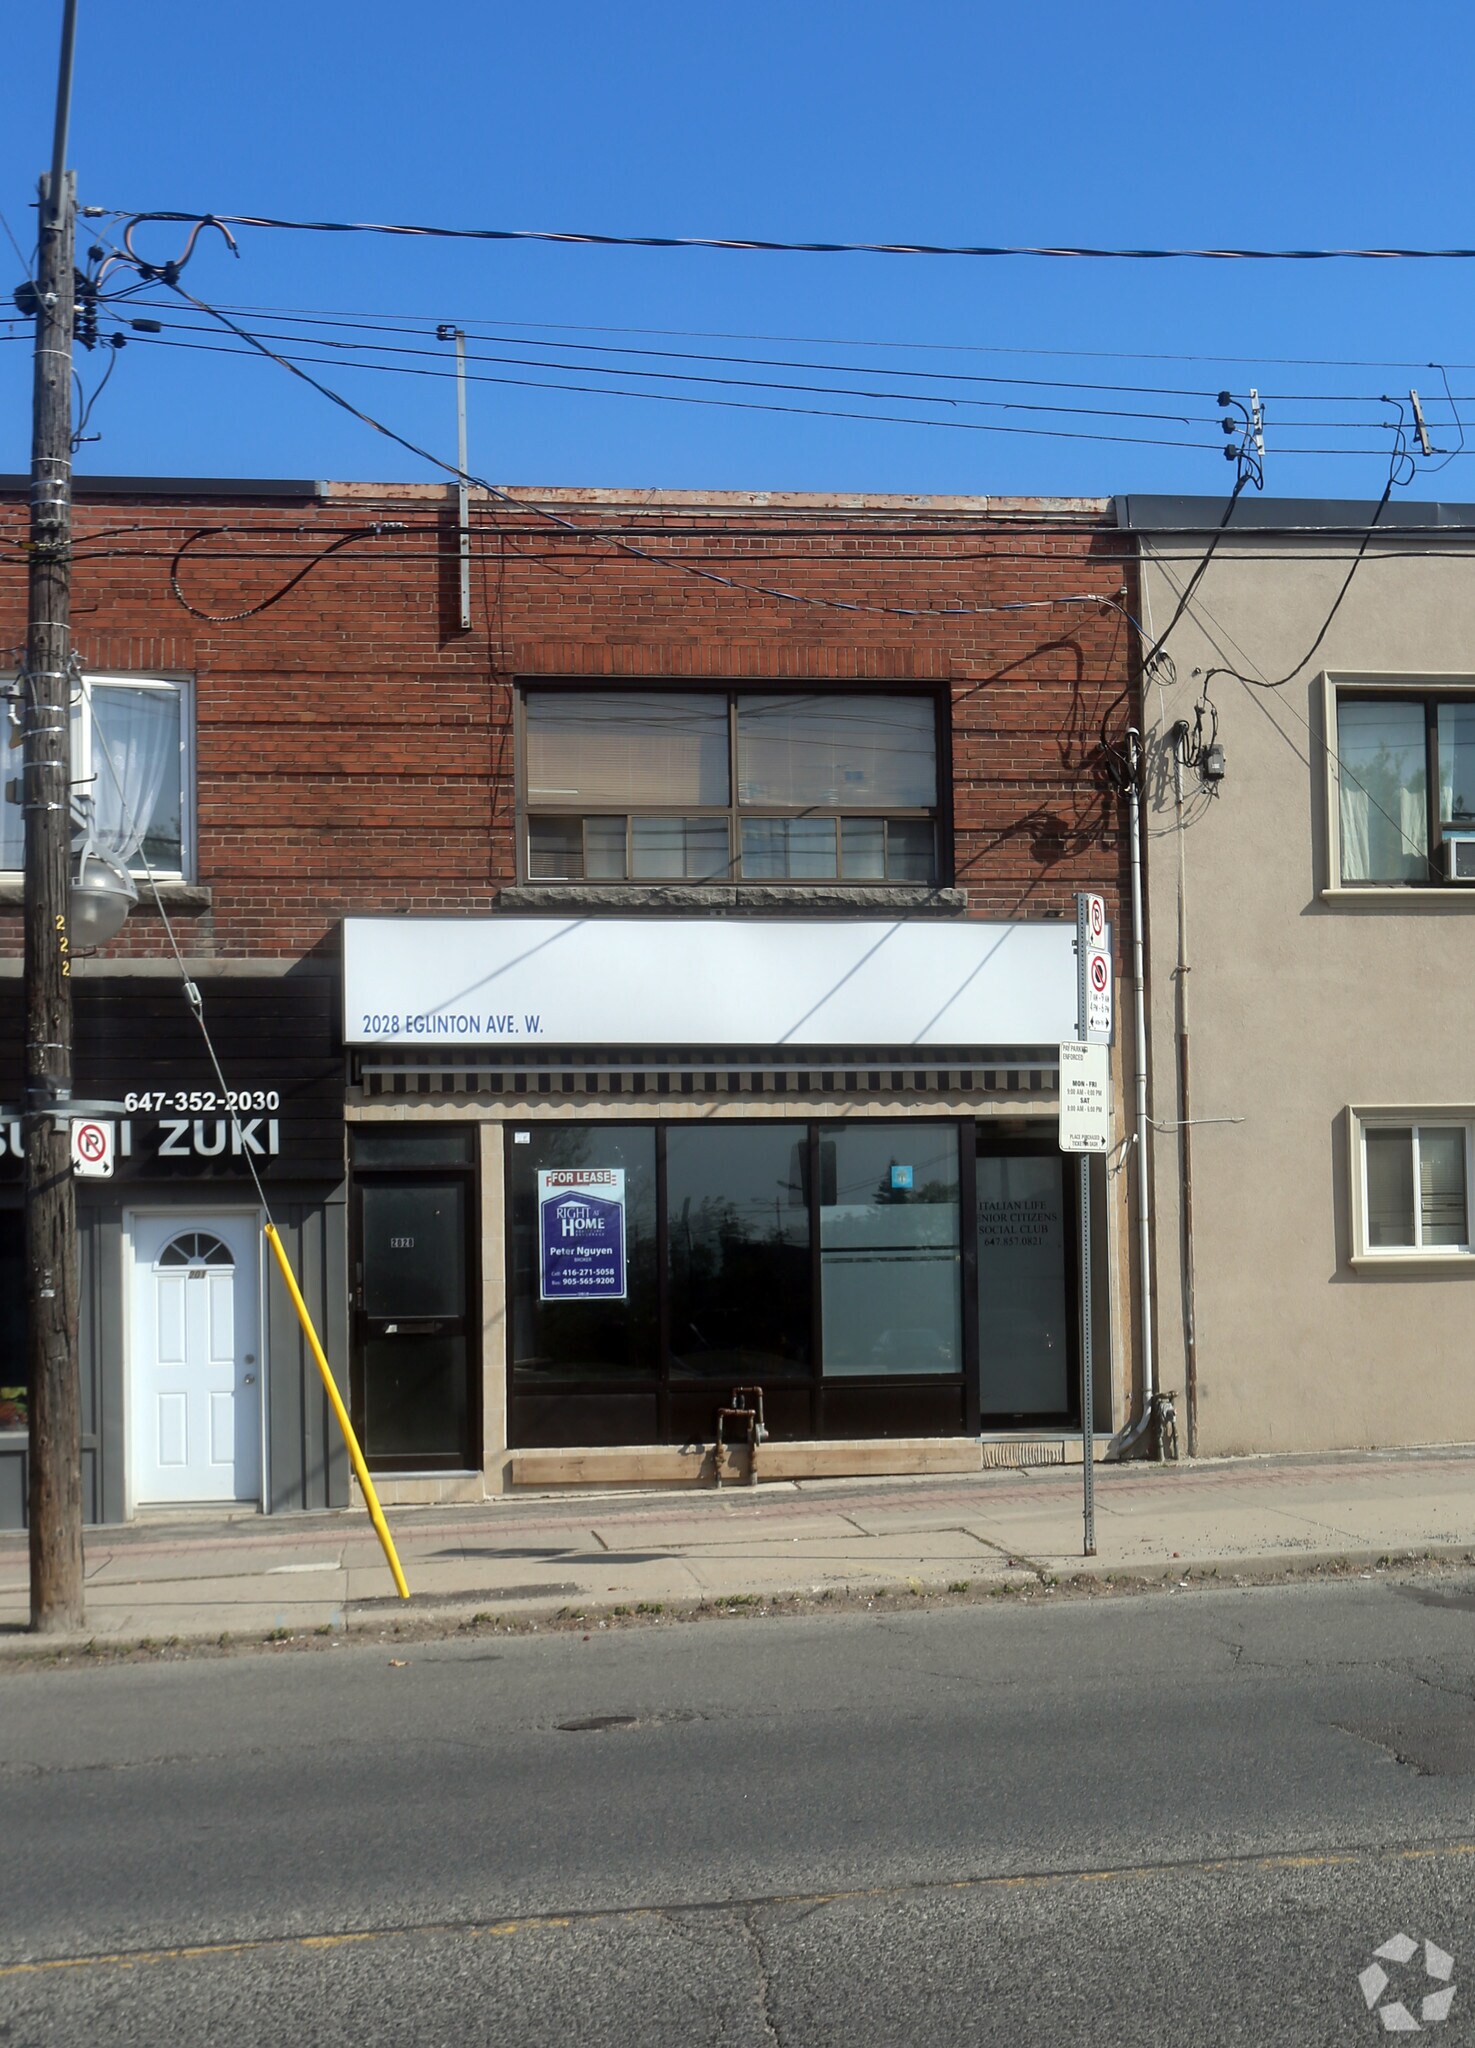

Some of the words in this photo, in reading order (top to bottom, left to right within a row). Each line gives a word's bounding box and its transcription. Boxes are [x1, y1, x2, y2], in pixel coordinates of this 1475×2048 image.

[363, 1015, 400, 1033] 2028
[406, 1015, 480, 1033] EGLINTON
[486, 1015, 519, 1033] AVE.
[525, 1015, 543, 1033] W.
[124, 1091, 279, 1112] 647-352-2030
[158, 1119, 279, 1156] ZUKI
[552, 1172, 574, 1184] FOR
[576, 1171, 610, 1183] LEASE
[979, 1201, 1021, 1211] ITALIAN
[556, 1207, 591, 1219] RIGHT
[1010, 1212, 1057, 1222] CITIZENS
[561, 1218, 605, 1237] HOME
[979, 1225, 1016, 1235] SOCIAL
[1019, 1224, 1049, 1234] CLUB
[550, 1247, 575, 1256] Peter
[576, 1246, 613, 1257] Nguyen
[562, 1268, 615, 1276] 416-271-5058
[562, 1277, 615, 1286] 905-565-9200
